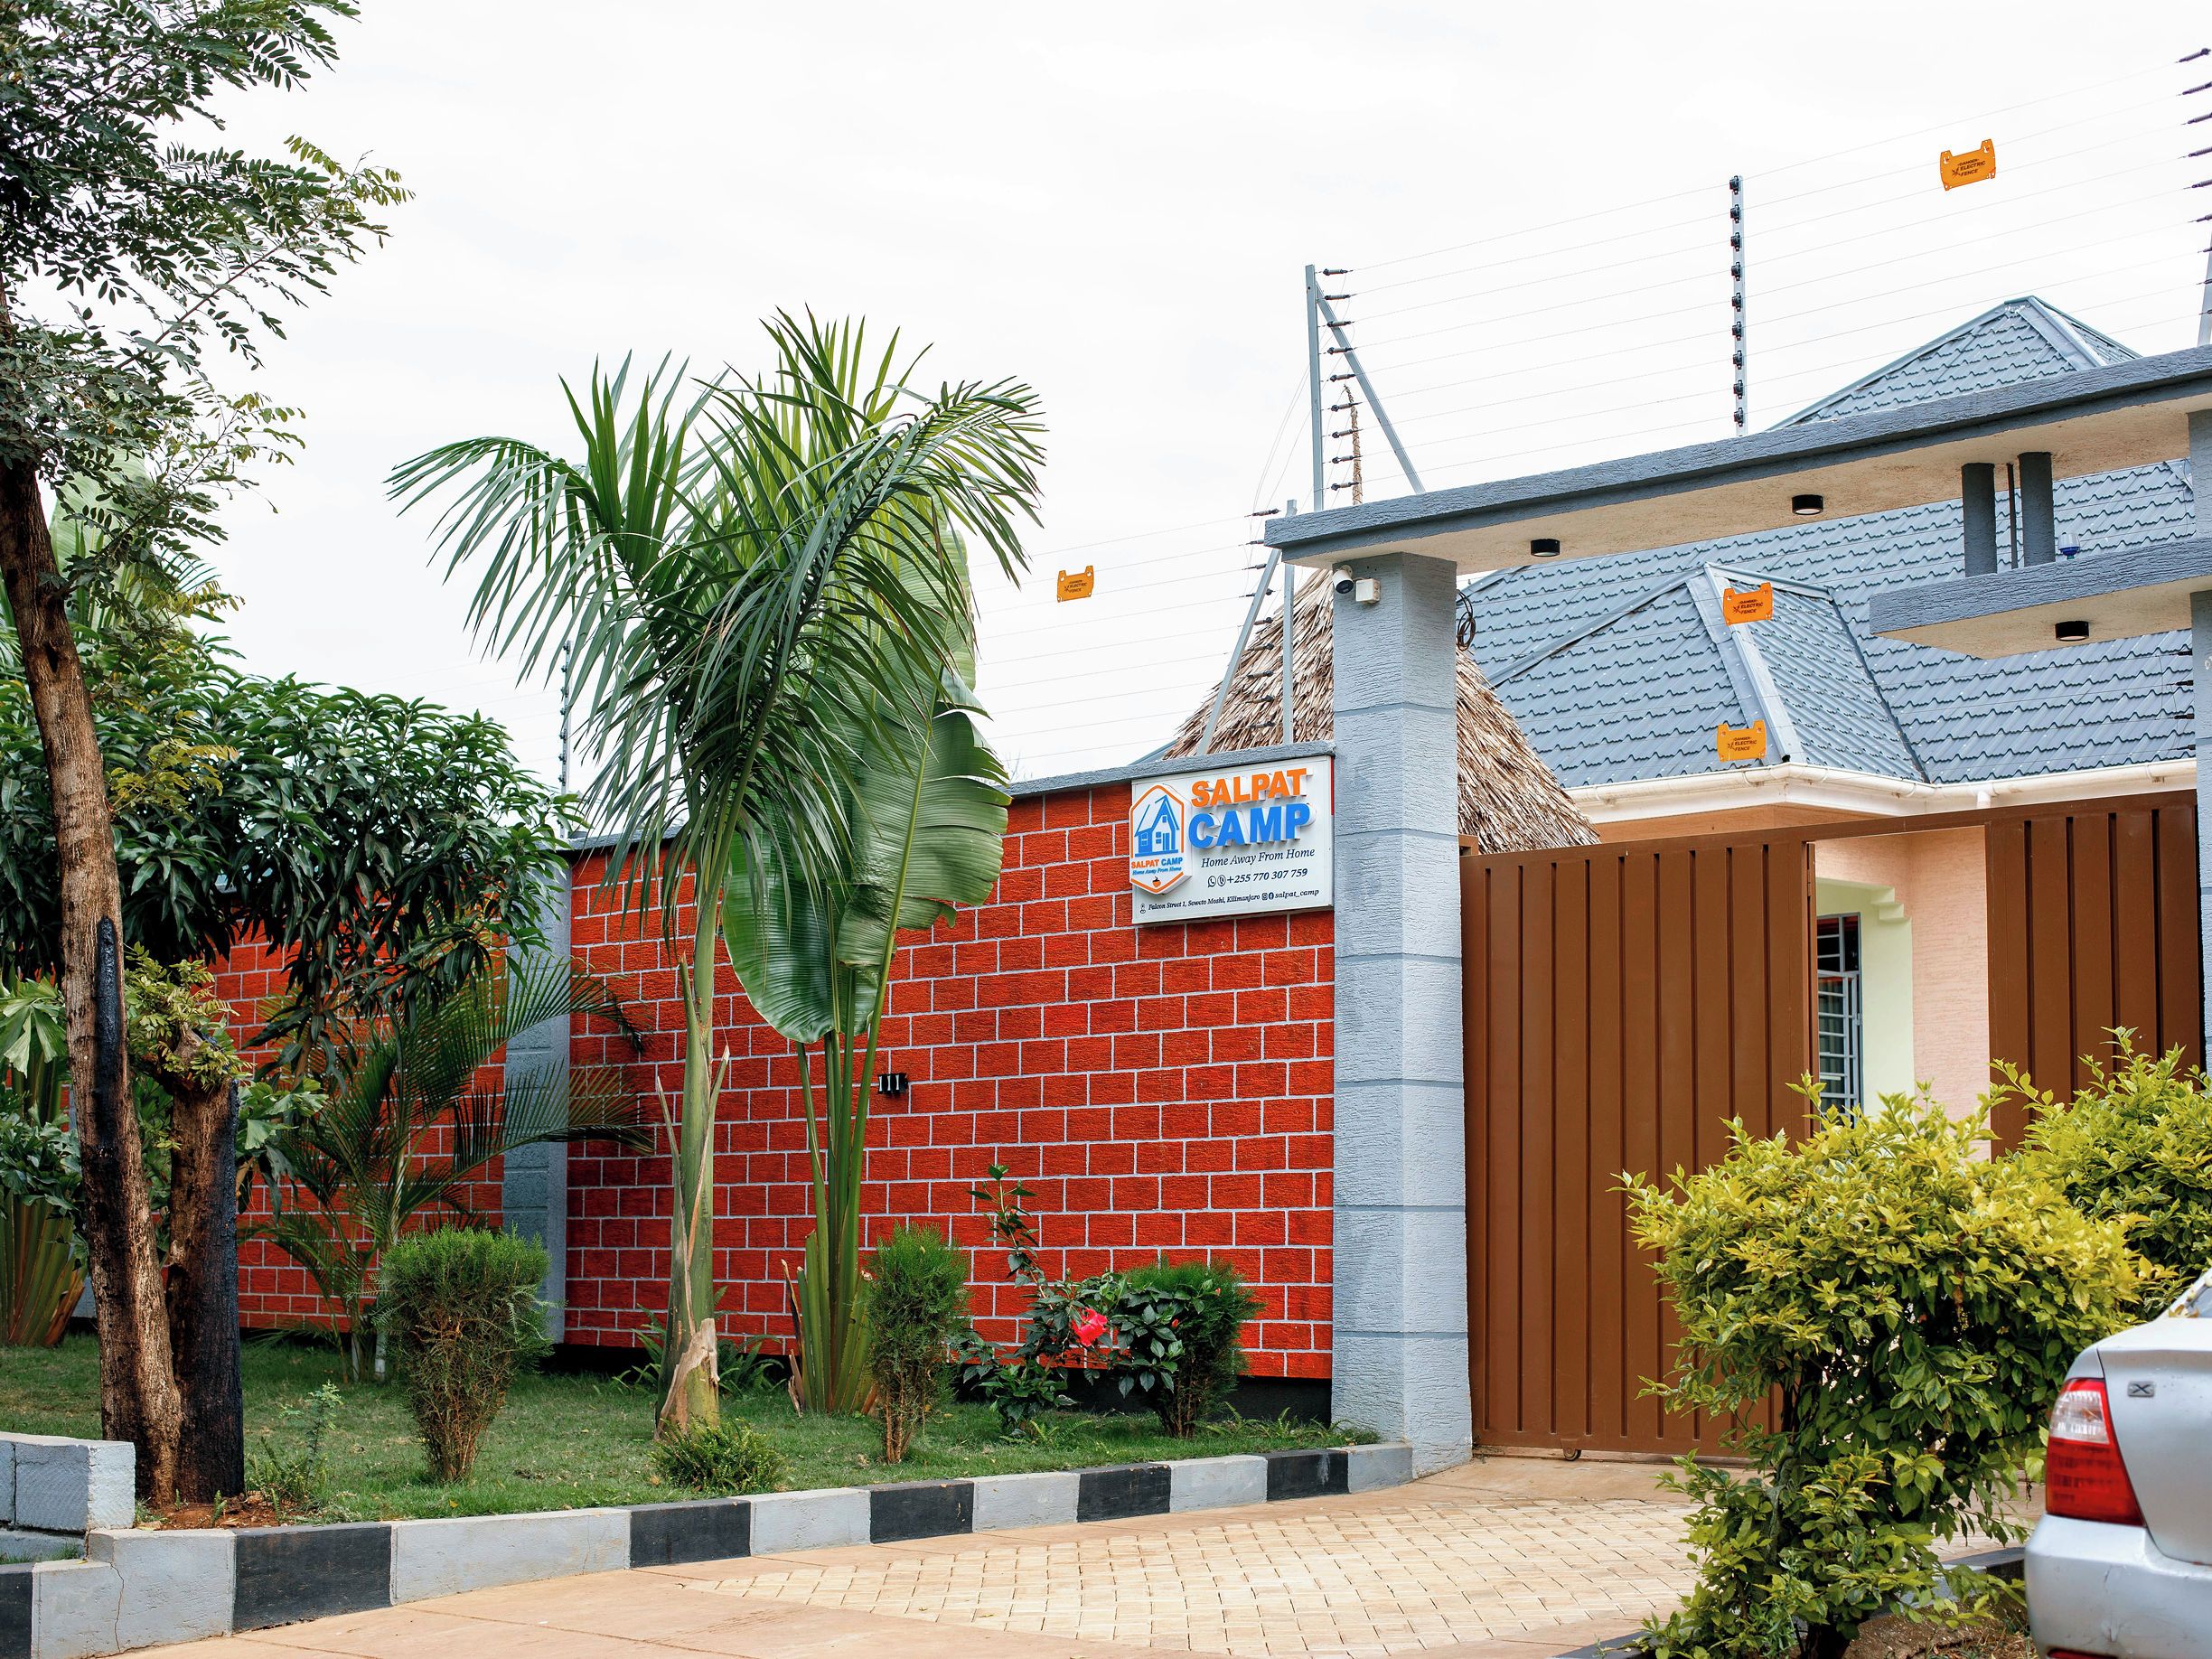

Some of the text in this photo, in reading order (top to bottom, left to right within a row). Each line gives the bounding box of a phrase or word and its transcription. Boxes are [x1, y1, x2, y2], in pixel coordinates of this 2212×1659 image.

[1960, 161, 1985, 171] ELECTRIC
[1191, 768, 1307, 808] SALPAT
[1188, 802, 1311, 849] CAMP
[1131, 857, 1183, 869] SALPAT CAMP
[1201, 848, 1315, 868] Home Away From Home
[1227, 867, 1308, 884] +255 770 307 759
[1275, 889, 1319, 899] salpat_camp
